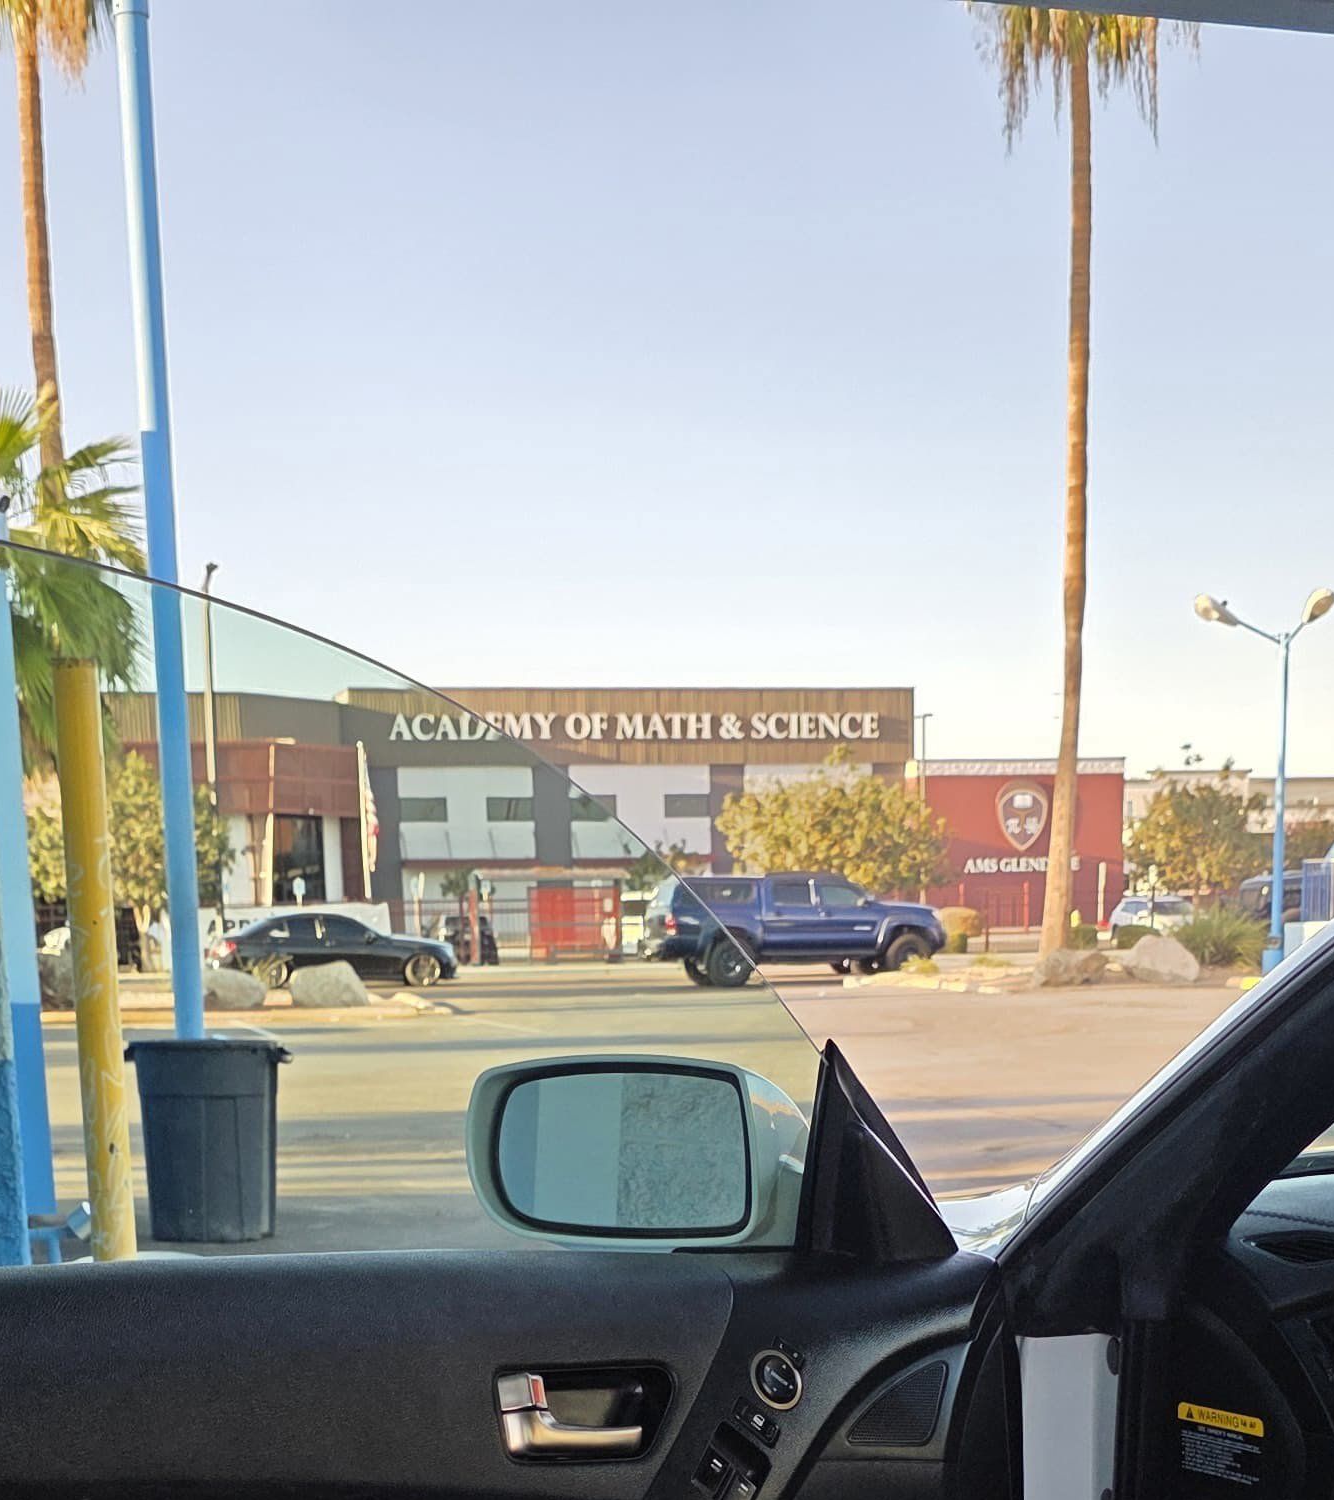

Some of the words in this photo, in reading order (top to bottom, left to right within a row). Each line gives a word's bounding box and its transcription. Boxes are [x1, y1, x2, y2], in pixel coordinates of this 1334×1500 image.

[389, 713, 553, 742] ACADEMY
[565, 712, 609, 740] OF
[615, 712, 713, 741] MATH
[719, 712, 746, 740] &
[751, 711, 880, 740] SCIENCE
[964, 858, 998, 873] AMS
[1197, 1408, 1240, 1429] WARNING
